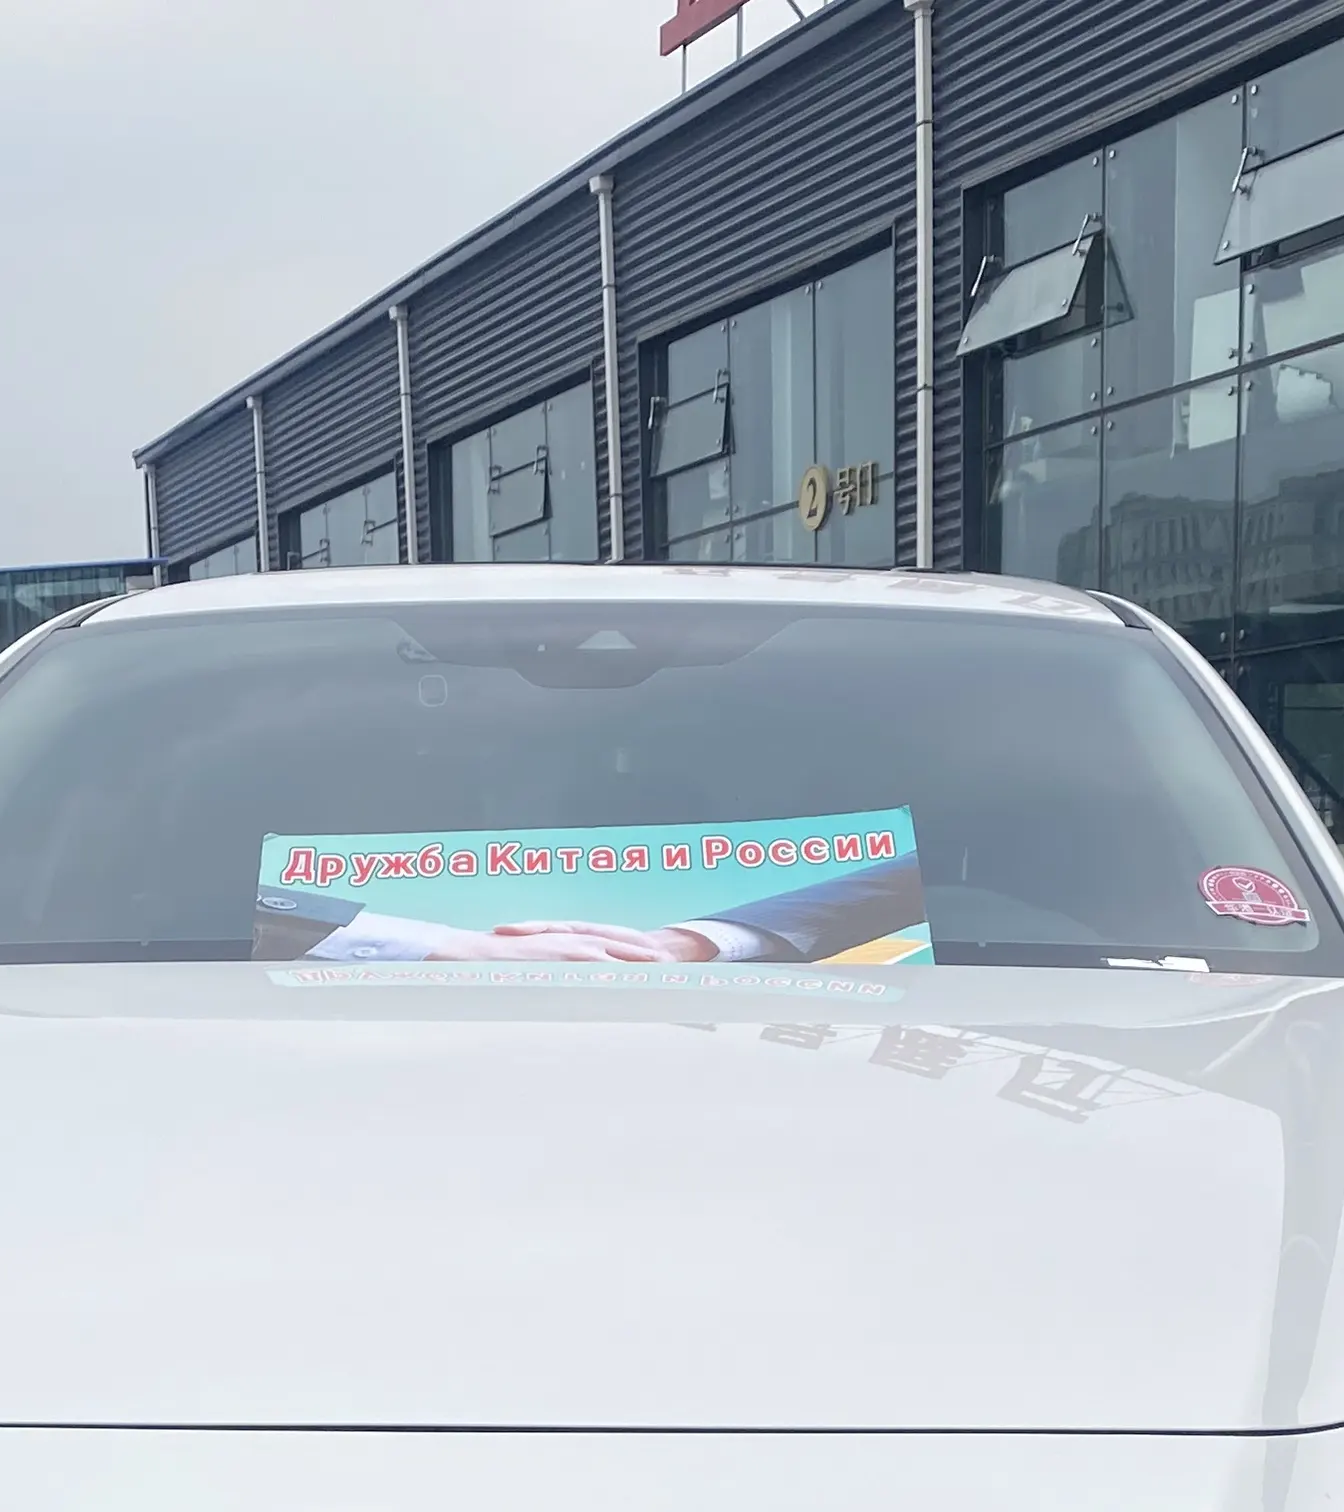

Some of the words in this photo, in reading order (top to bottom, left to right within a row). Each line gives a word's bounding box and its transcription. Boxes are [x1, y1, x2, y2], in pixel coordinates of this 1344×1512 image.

[281, 846, 477, 887] Дружба
[487, 843, 650, 875] Китая
[661, 843, 689, 870] и
[701, 831, 896, 870] России
